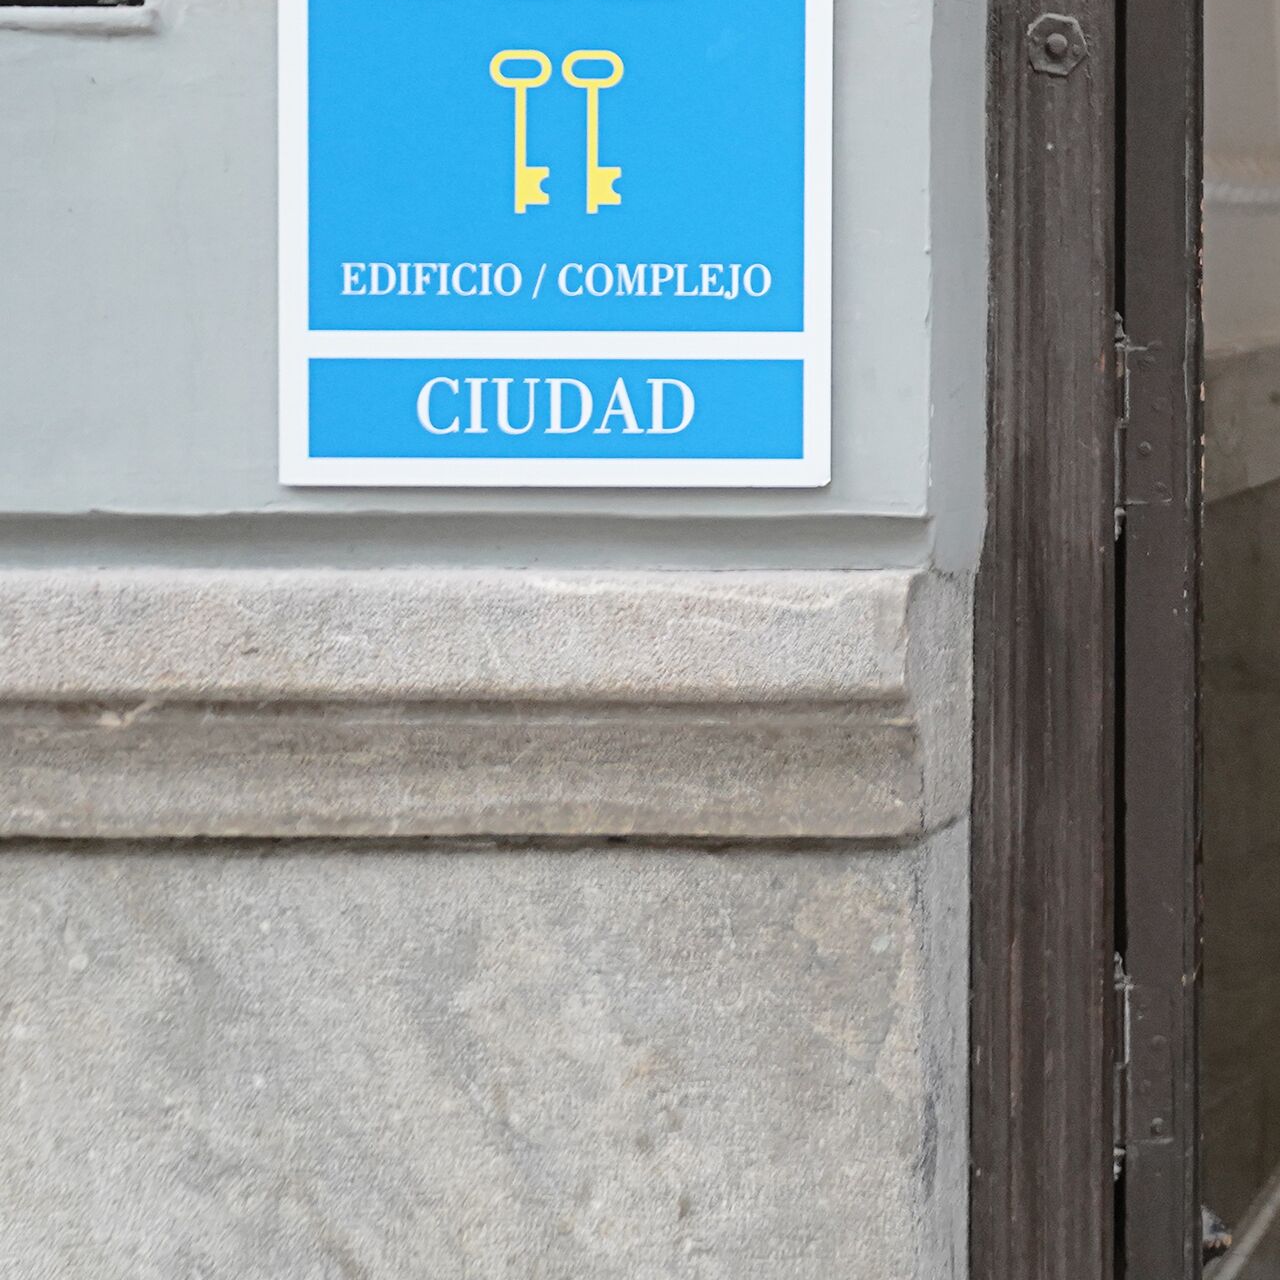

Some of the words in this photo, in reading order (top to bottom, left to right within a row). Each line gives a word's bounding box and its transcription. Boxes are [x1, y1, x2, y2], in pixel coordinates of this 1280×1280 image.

[341, 262, 523, 300] EDIFICIO
[532, 261, 547, 301] /
[557, 262, 773, 301] COMPLEJO
[416, 376, 696, 435] CIUDAD
